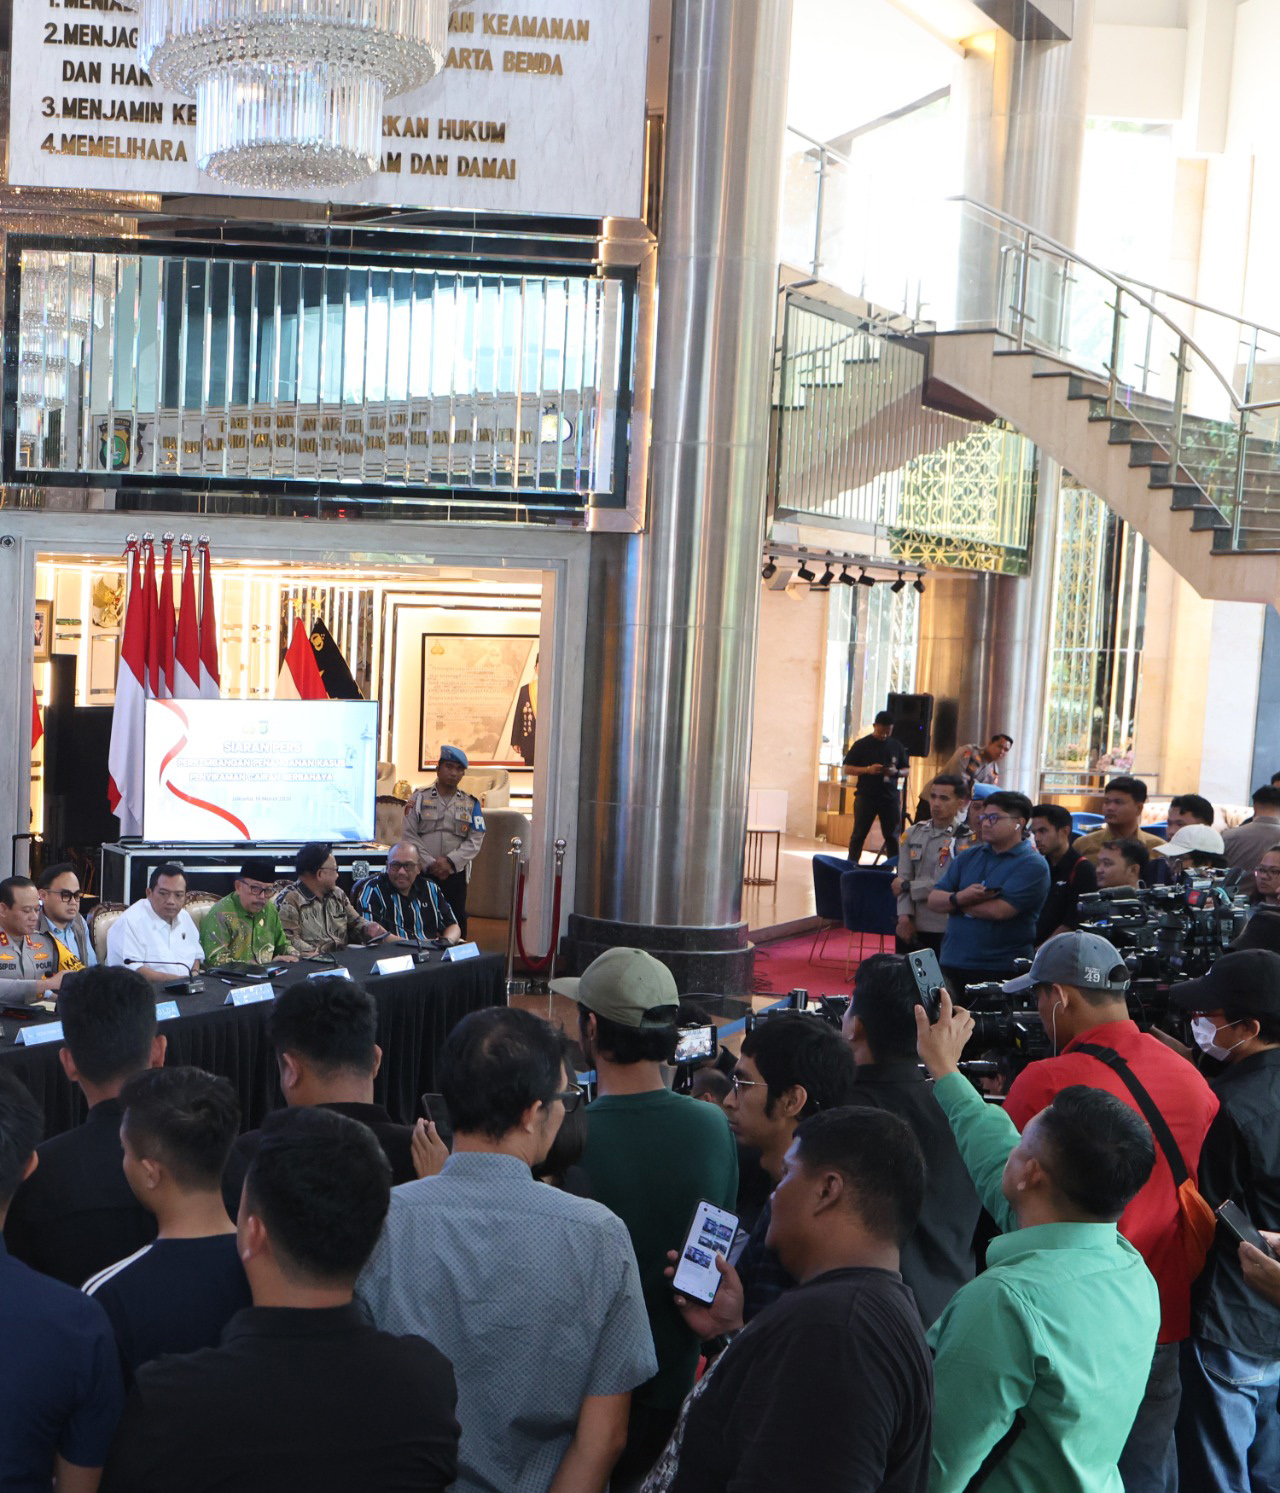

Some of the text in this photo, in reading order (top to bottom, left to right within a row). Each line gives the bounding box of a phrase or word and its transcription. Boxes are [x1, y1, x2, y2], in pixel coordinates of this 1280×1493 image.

[43, 11, 590, 48] 2.MENJAG AN KEAMANAN
[62, 60, 102, 84] DAN
[445, 47, 494, 72] ARTA
[503, 50, 564, 76] BENDA
[438, 118, 506, 144] HUKUM
[410, 153, 448, 176] DAN
[457, 155, 516, 180] DAMAI
[223, 741, 302, 754] SIARAN PERS
[1084, 972, 1101, 983] 49
[157, 1007, 177, 1016] OLDA
